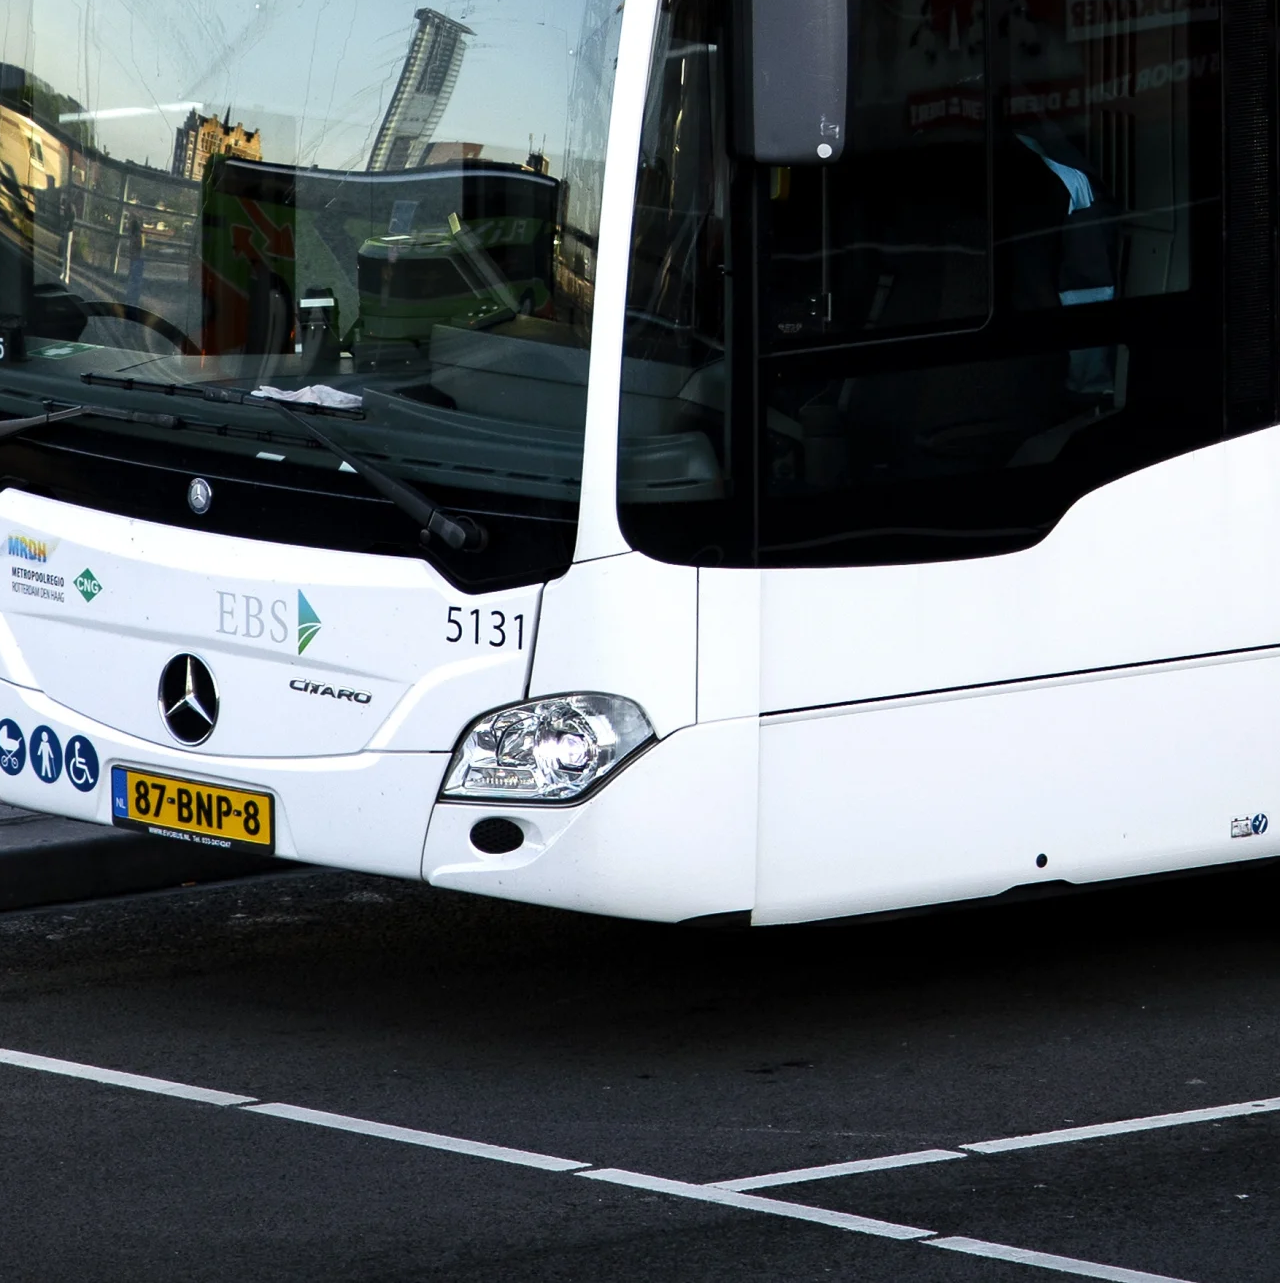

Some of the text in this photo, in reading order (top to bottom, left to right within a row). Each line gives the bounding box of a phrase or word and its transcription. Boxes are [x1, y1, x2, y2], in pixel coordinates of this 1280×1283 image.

[7, 535, 47, 563] MRDH
[11, 566, 65, 588] METROPOOLREGIO
[76, 577, 99, 594] CNG
[11, 581, 65, 603] ROTTERDAM DEN HAAG
[216, 590, 288, 644] EBS
[446, 605, 524, 650] 5131
[289, 677, 372, 705] CITARO
[115, 779, 261, 836] NL 87-BNP-8
